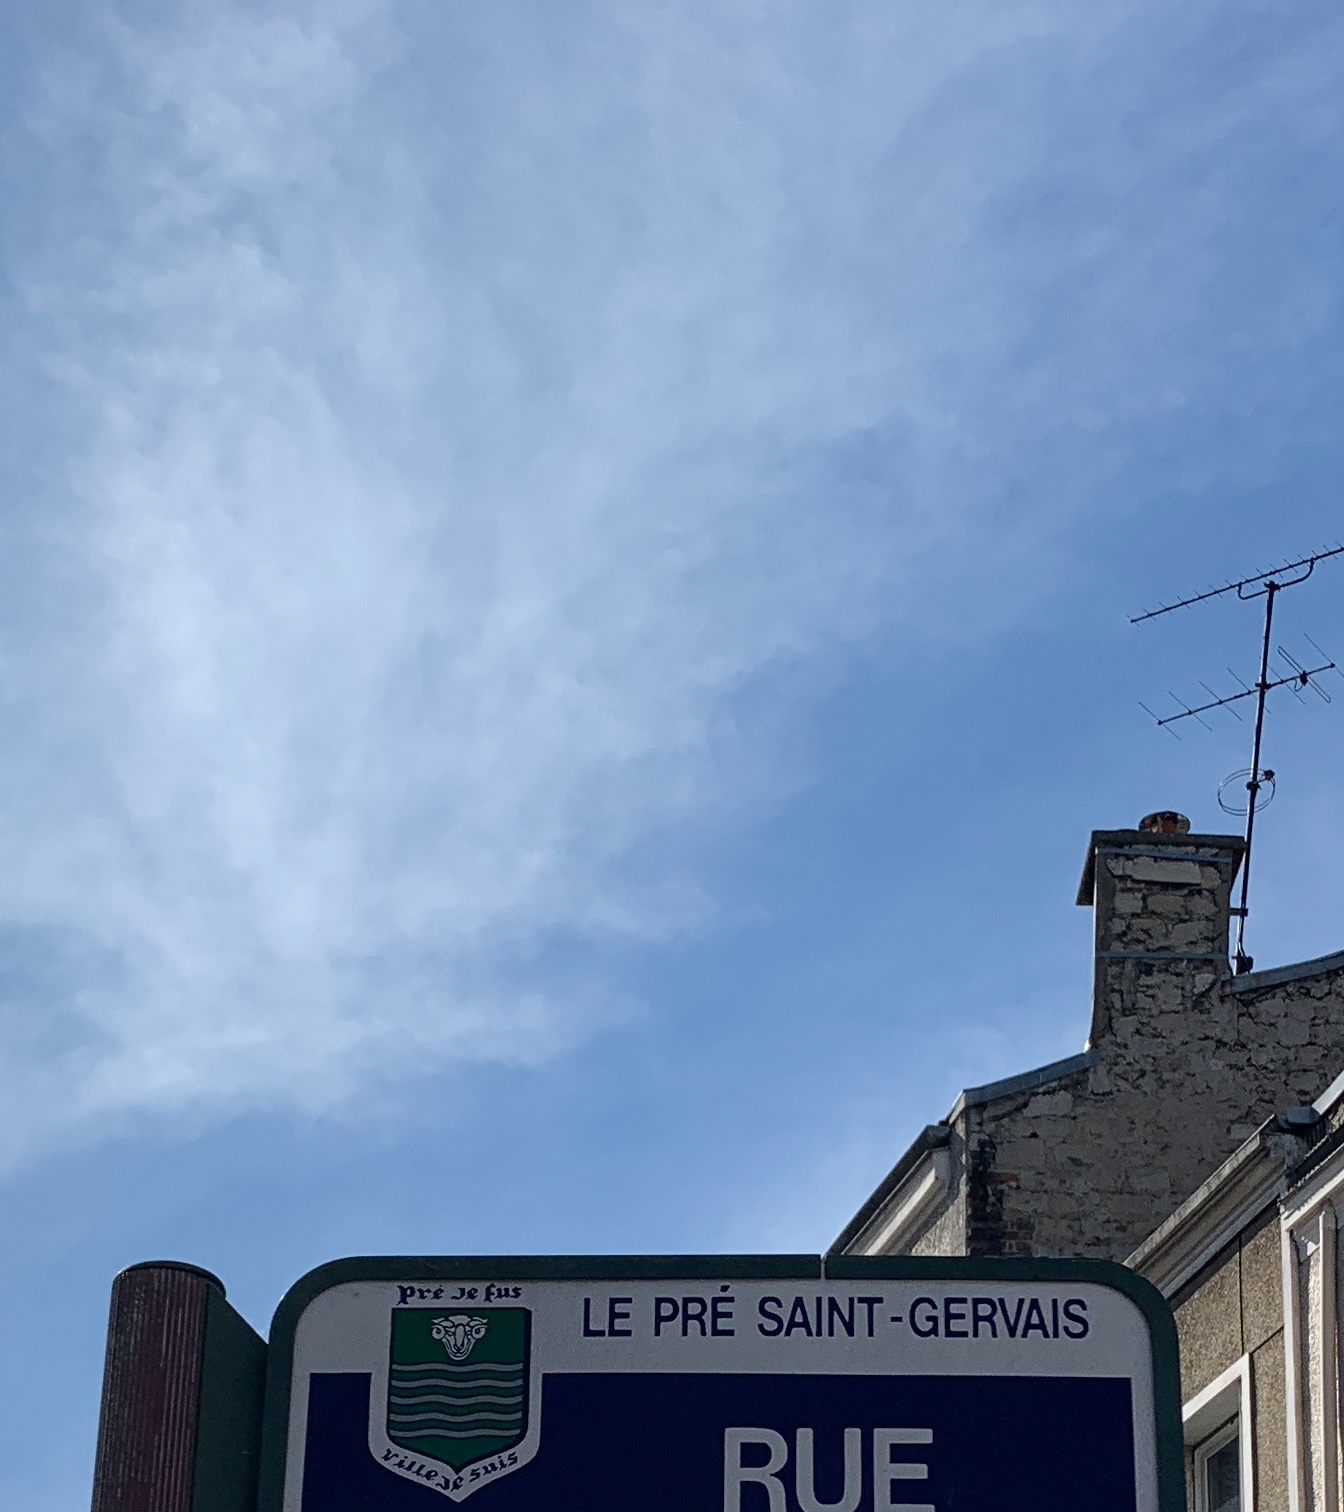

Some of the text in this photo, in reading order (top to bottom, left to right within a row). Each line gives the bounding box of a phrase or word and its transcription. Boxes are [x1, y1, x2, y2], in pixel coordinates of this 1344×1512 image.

[582, 1284, 1090, 1339] LE PRÉ SAINT-GERVAIS
